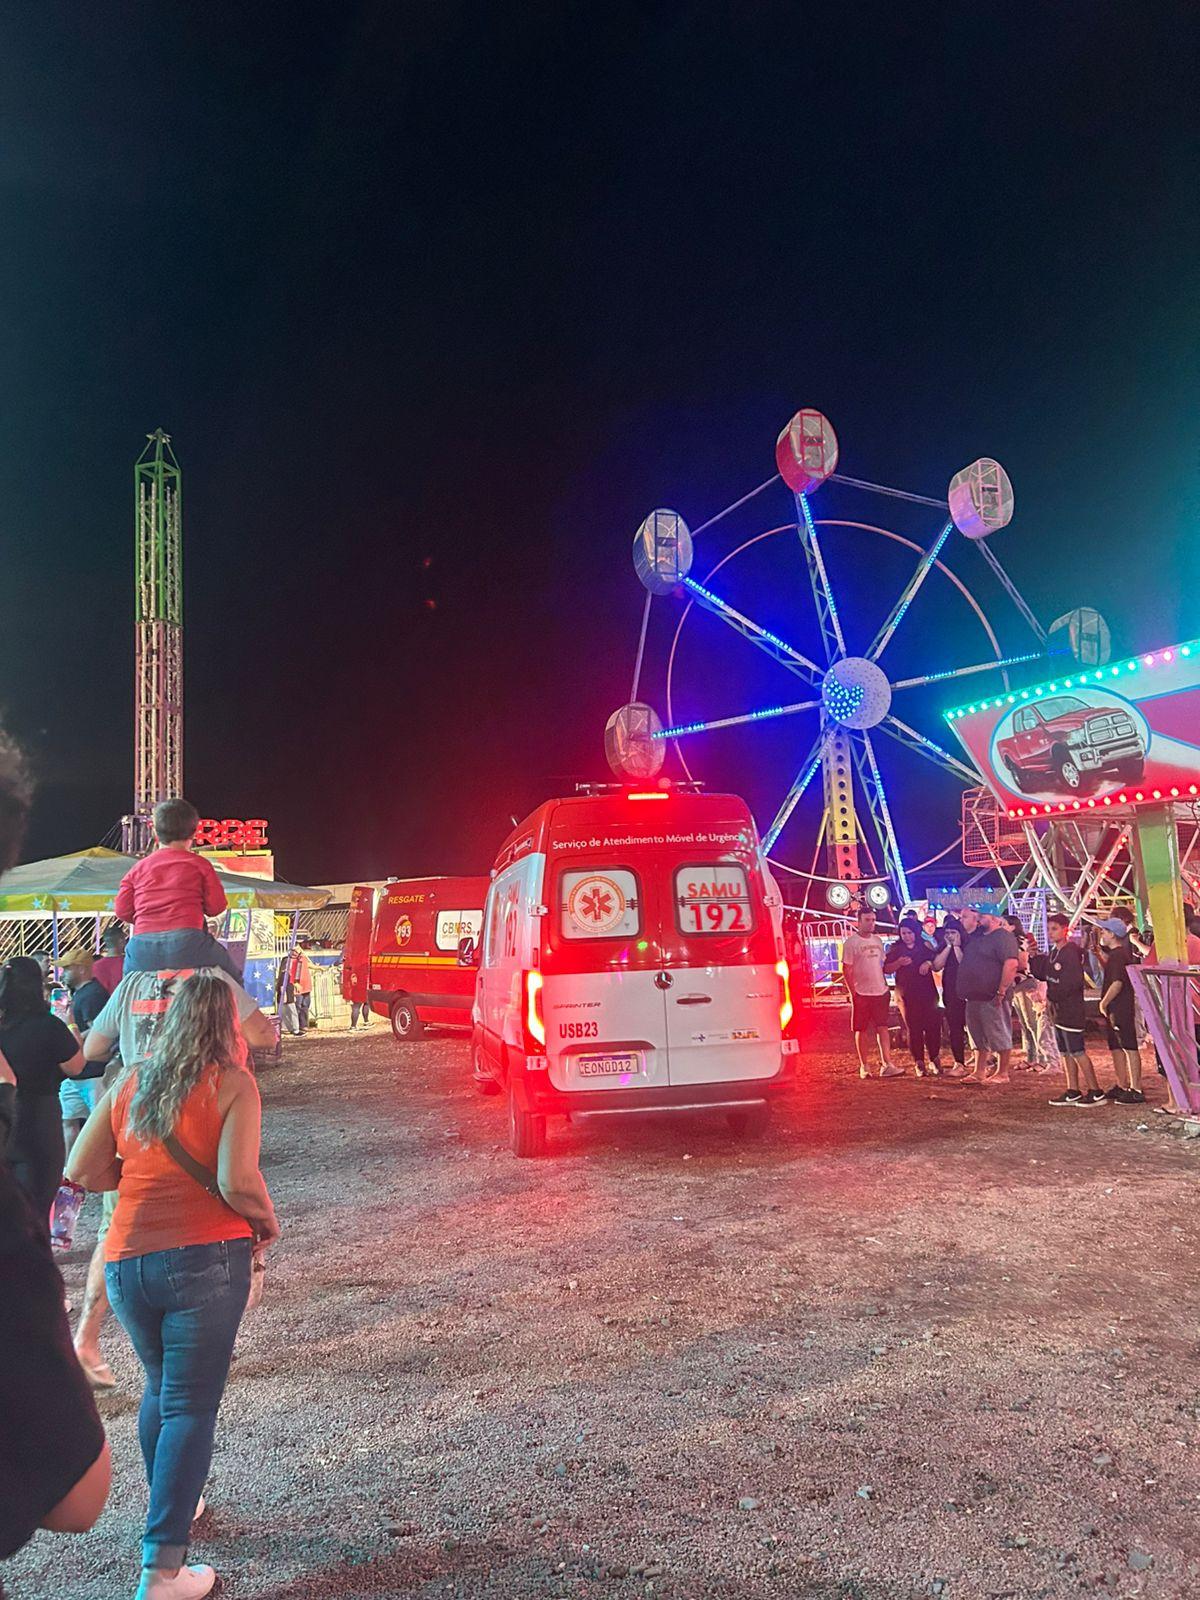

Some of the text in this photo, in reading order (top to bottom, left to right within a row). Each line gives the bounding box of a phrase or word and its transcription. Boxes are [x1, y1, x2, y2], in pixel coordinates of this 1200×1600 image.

[195, 819, 268, 846] RRE
[552, 840, 587, 850] Serviço
[589, 837, 601, 847] de
[603, 835, 664, 846] Atendimento
[665, 833, 694, 843] Móvel
[696, 833, 708, 842] de
[687, 883, 741, 898] SAMU
[388, 895, 425, 904] RESGATE
[690, 903, 746, 931] 192
[397, 925, 411, 938] 193
[559, 1022, 598, 1039] USB23
